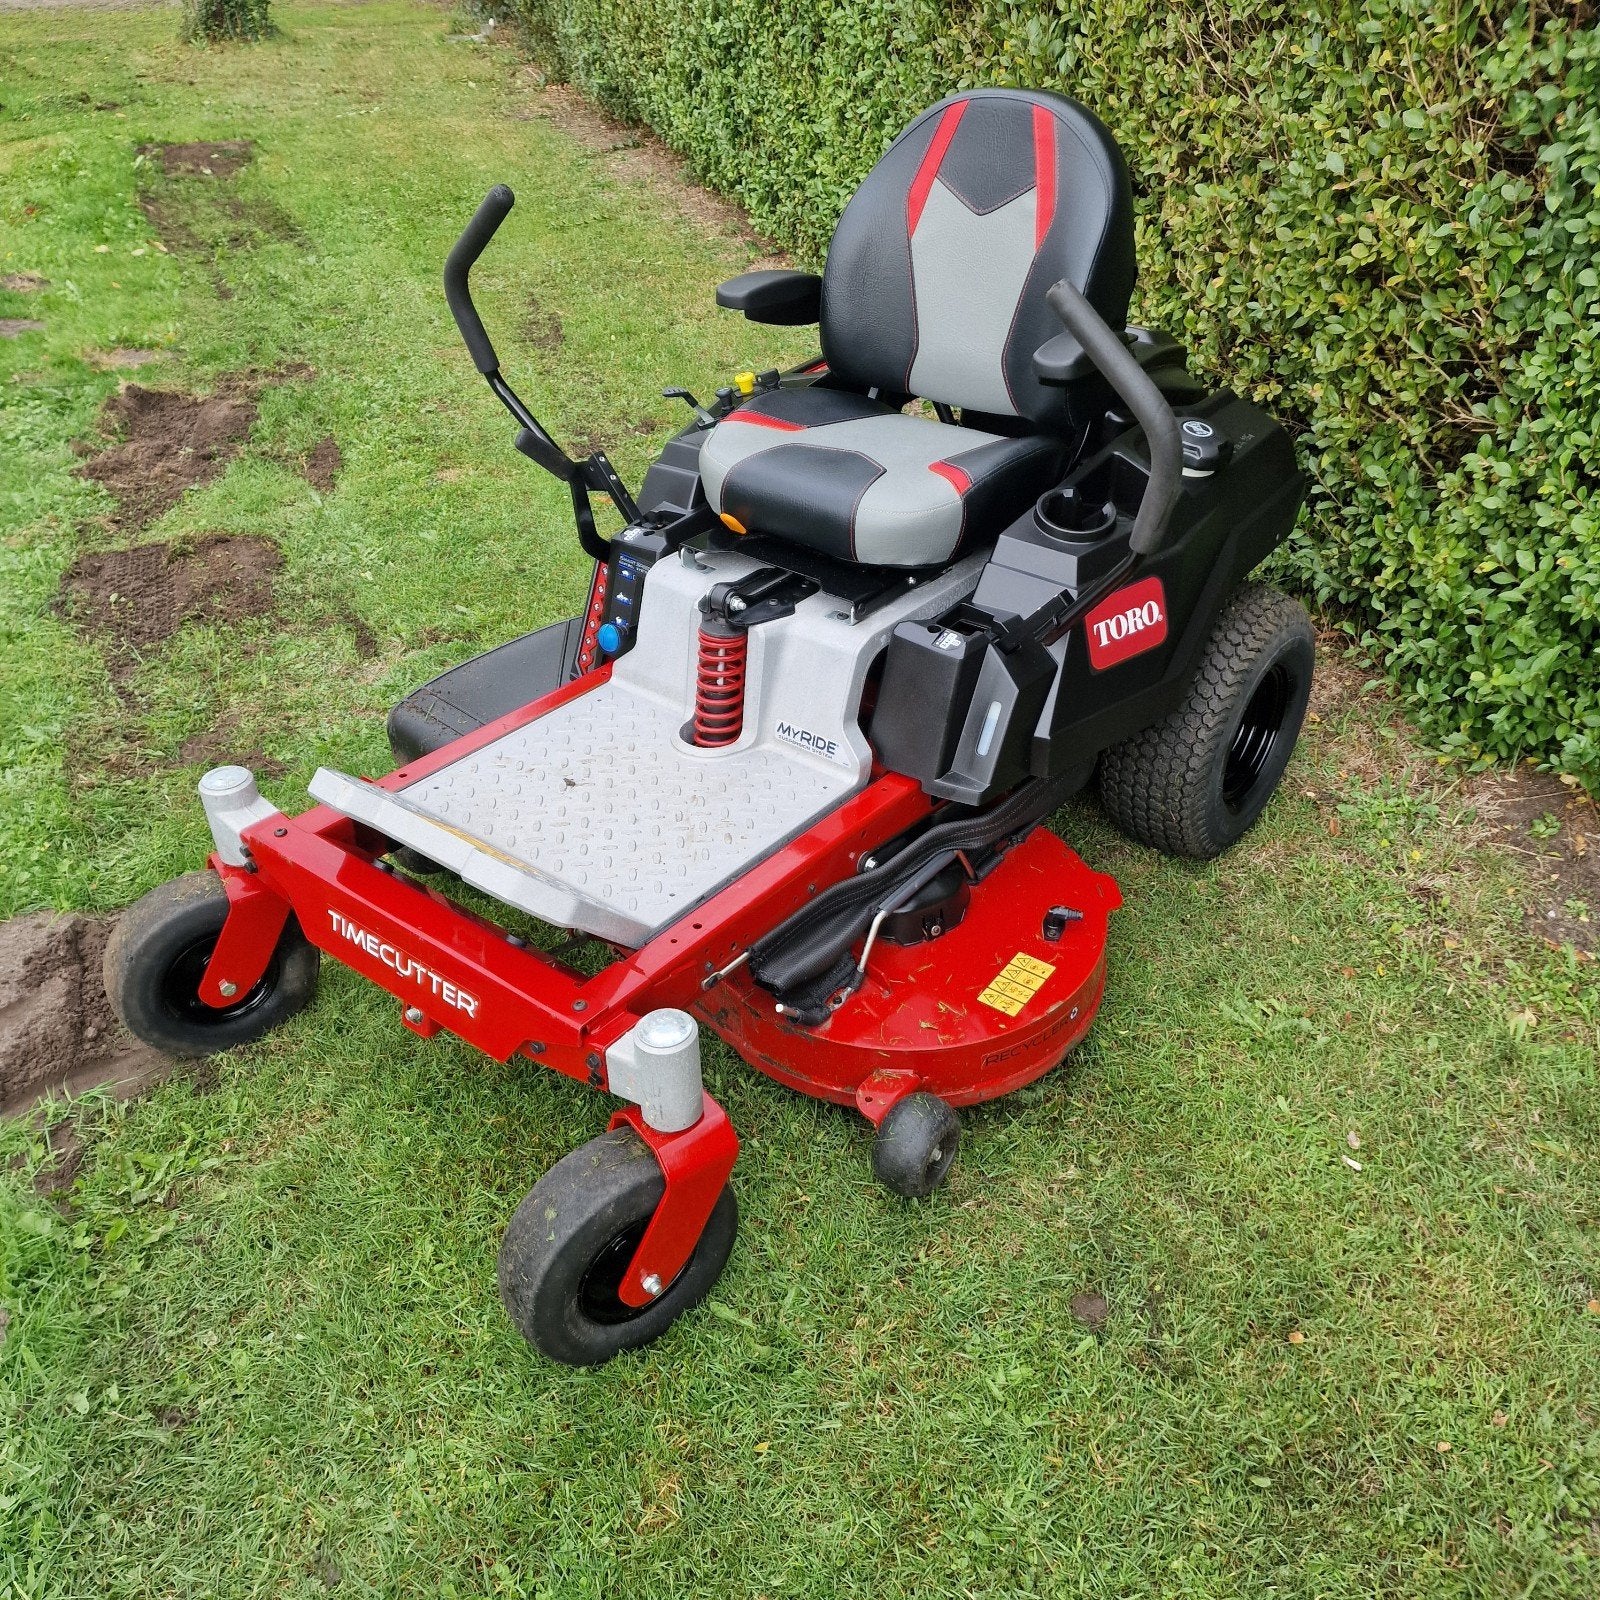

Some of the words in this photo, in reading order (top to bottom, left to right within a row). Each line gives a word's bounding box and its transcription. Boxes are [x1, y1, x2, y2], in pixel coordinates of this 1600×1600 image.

[1093, 600, 1160, 648] TORO
[327, 909, 476, 1019] TIMECUTTER
[984, 1014, 1070, 1067] RECYCLER
